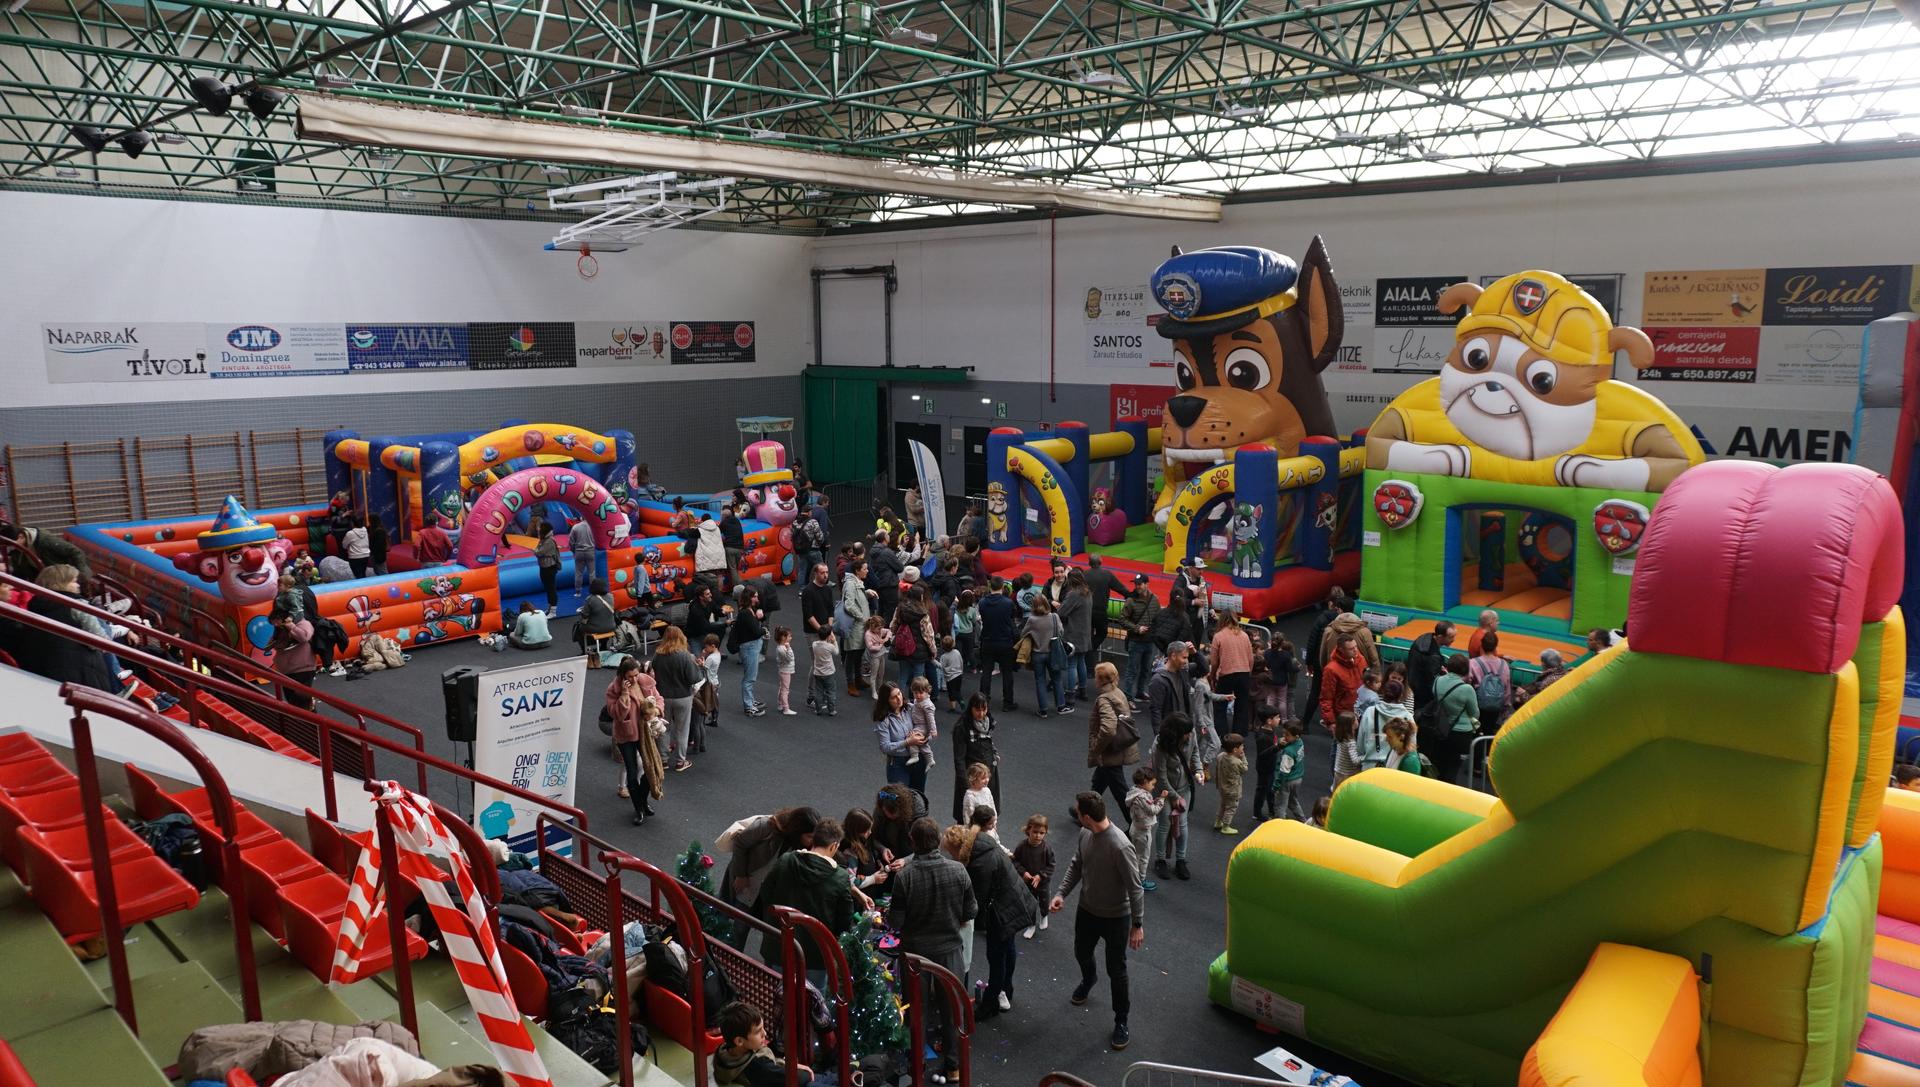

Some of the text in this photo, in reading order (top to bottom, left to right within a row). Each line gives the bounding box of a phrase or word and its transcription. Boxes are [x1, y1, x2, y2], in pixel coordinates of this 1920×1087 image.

[1384, 286, 1431, 301] AIALA
[1777, 274, 1885, 304] Loidi
[233, 330, 273, 347] JM
[392, 328, 455, 350] AIALA
[1093, 335, 1142, 348] SANTOS
[579, 345, 632, 358] naparberri
[1389, 329, 1444, 367] Lukas
[221, 351, 290, 364] Dominguez
[1718, 356, 1752, 365] denda
[1641, 369, 1661, 378] 24h
[1683, 369, 1754, 380] 650.897.497
[493, 672, 574, 697] ATRACCIONES
[501, 688, 564, 717] SANZ
[515, 753, 540, 767] ONGI
[545, 763, 568, 775] VENI
